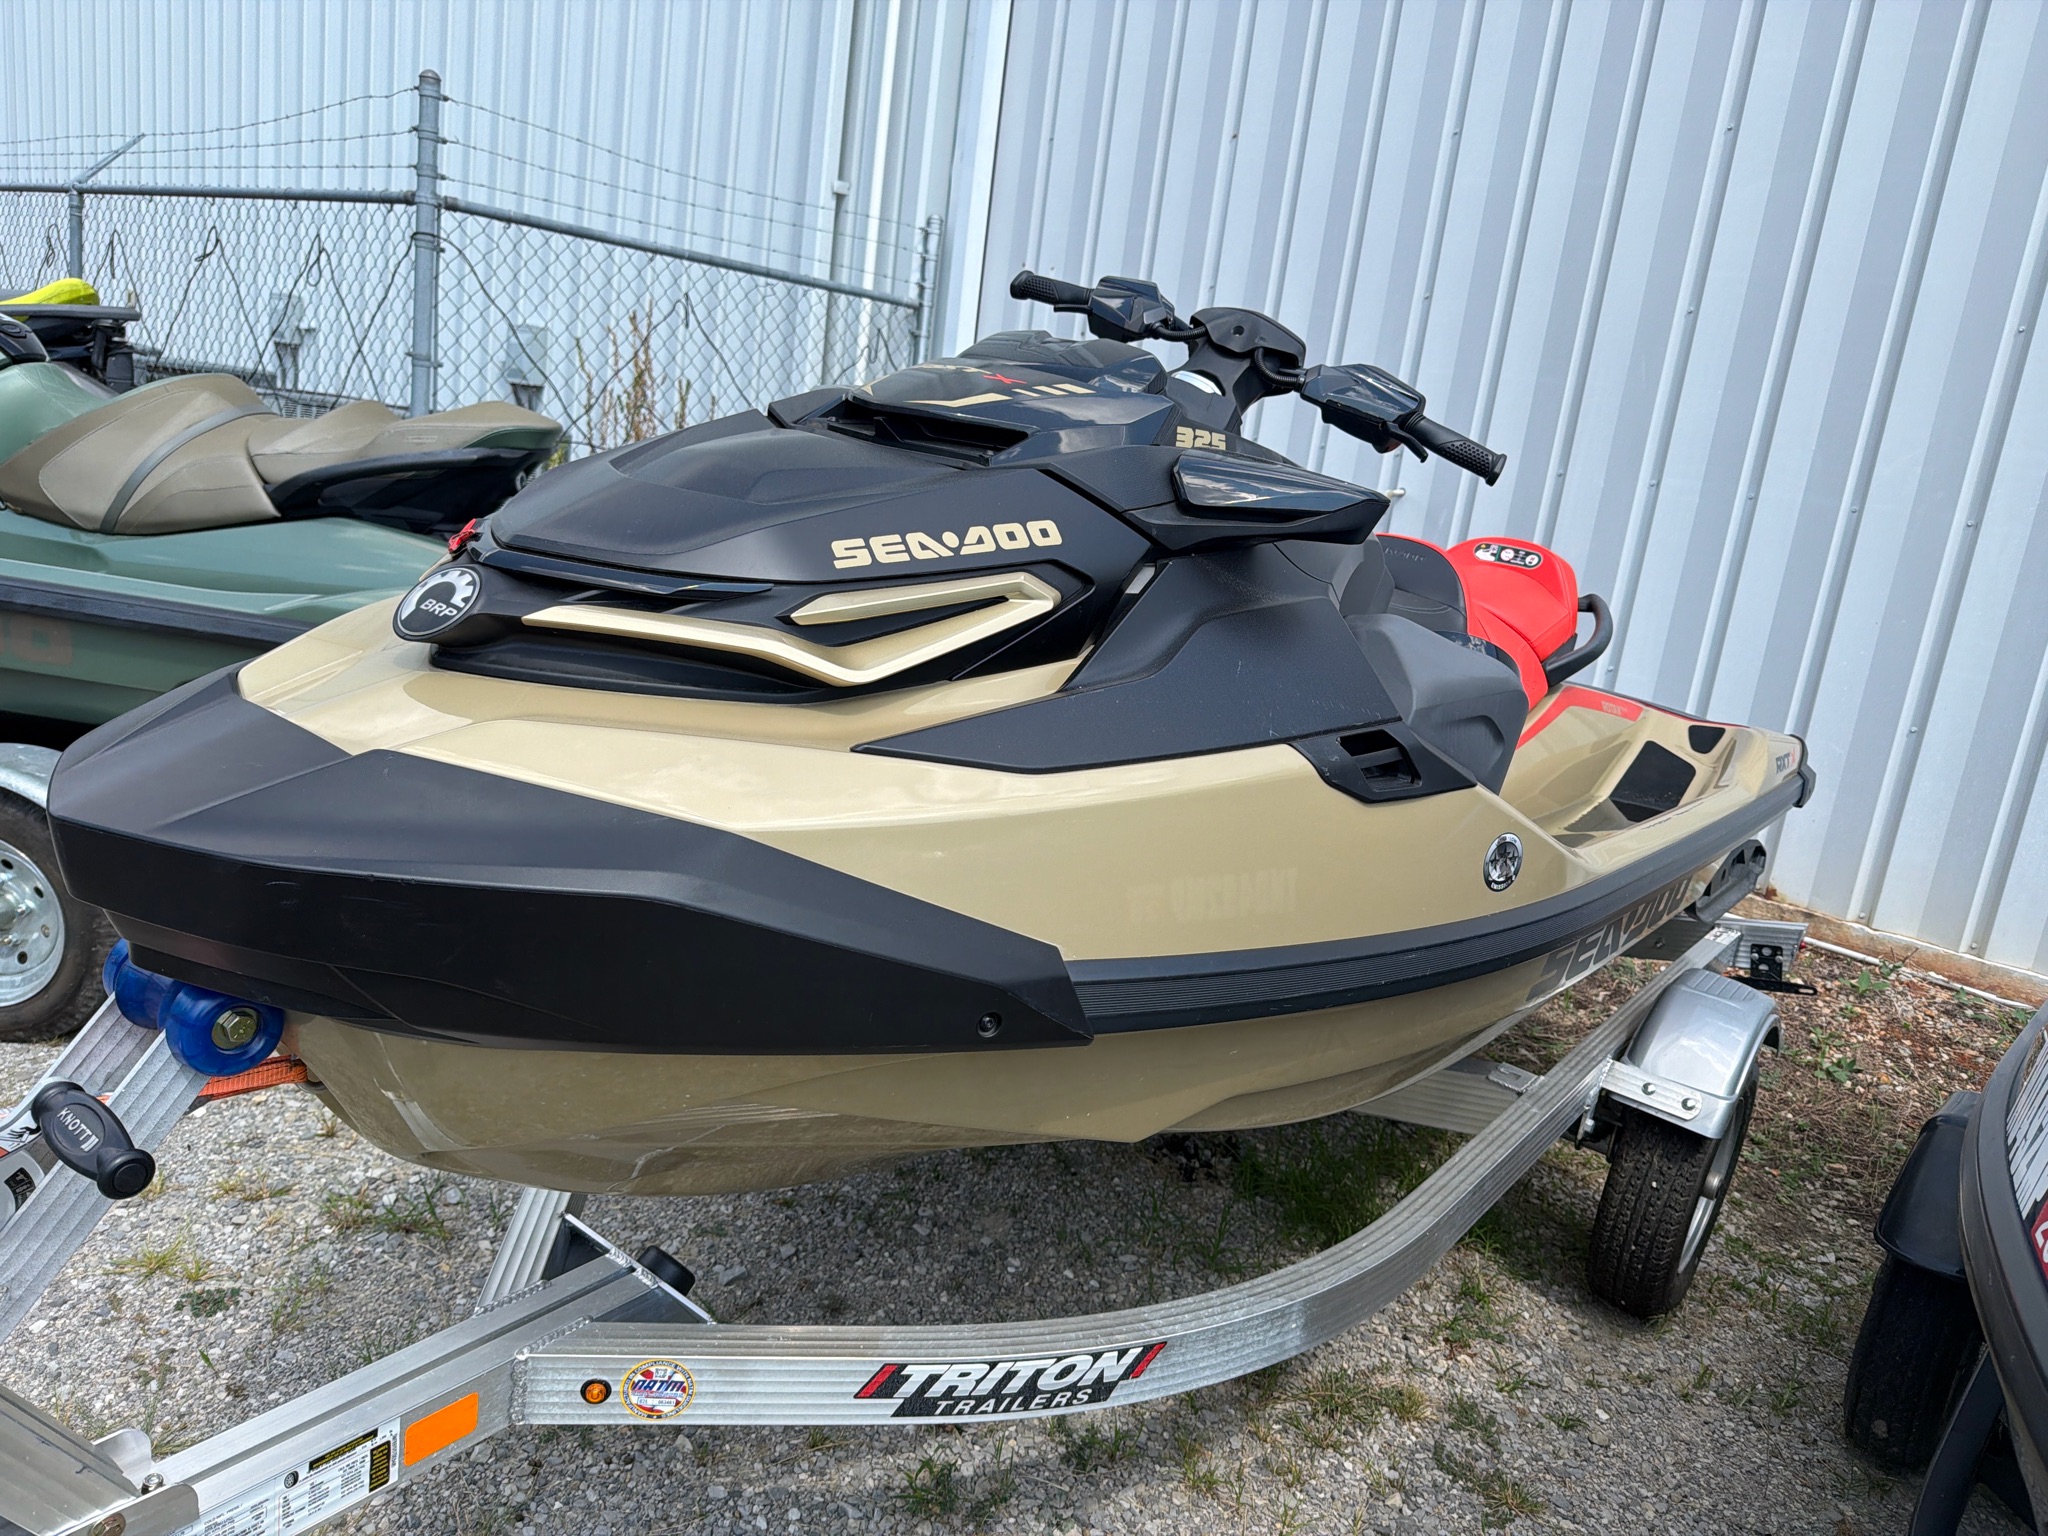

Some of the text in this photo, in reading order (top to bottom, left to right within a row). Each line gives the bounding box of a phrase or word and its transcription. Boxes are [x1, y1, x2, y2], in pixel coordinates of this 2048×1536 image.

[1175, 426, 1226, 450] 325
[420, 598, 458, 617] BRP
[57, 1107, 93, 1142] KNOTT
[893, 1347, 1144, 1398] TRITON
[934, 1388, 1093, 1416] TRAILERS
